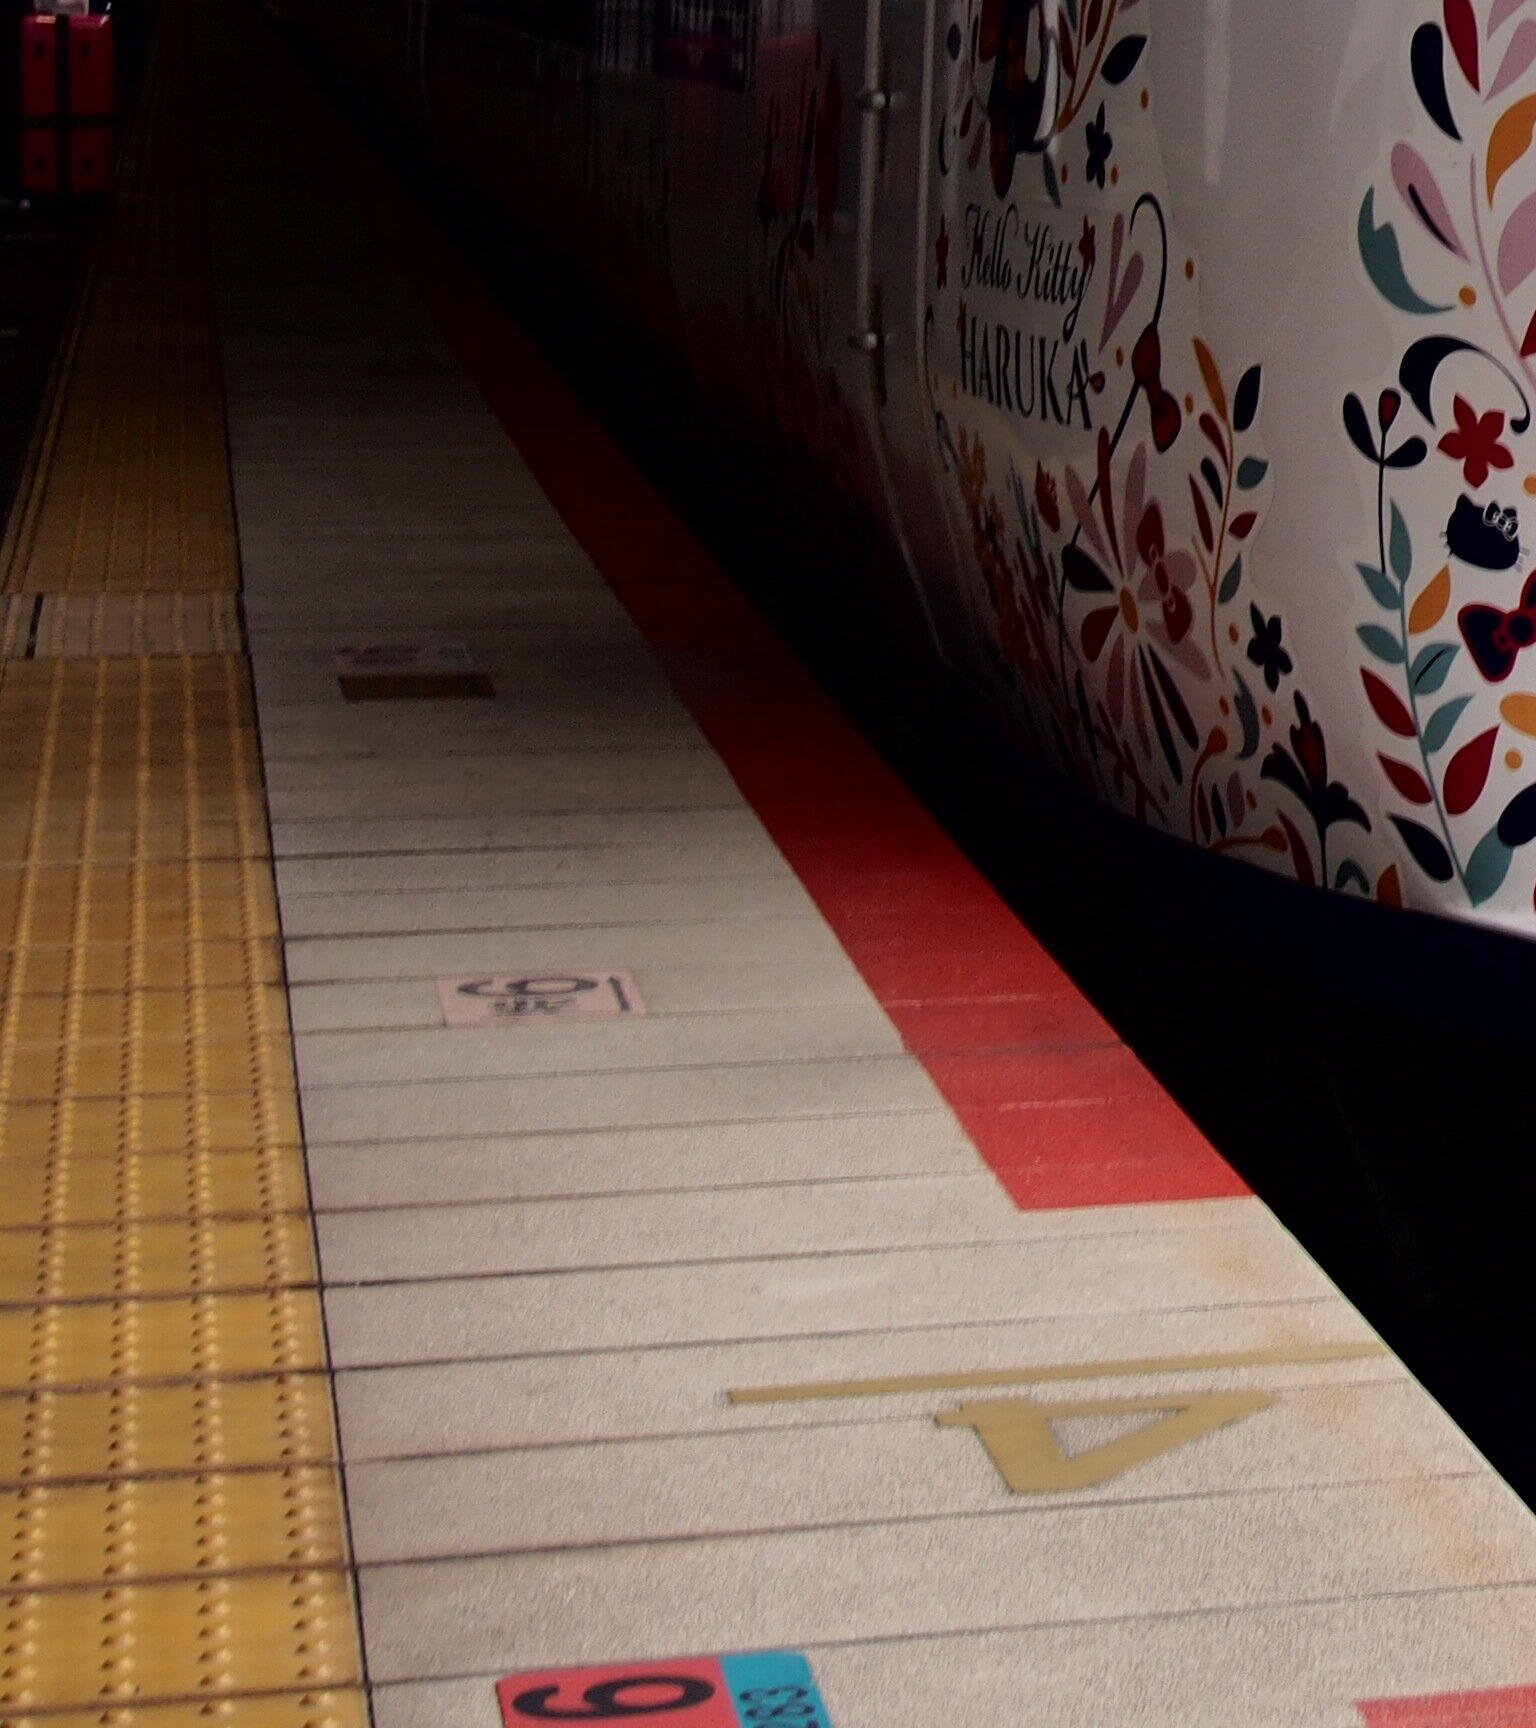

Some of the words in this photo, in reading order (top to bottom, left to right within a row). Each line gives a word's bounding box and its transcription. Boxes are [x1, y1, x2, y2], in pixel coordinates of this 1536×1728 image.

[961, 203, 1018, 291] Hello
[1017, 221, 1095, 343] Kitty
[960, 315, 1092, 430] HARUKA
